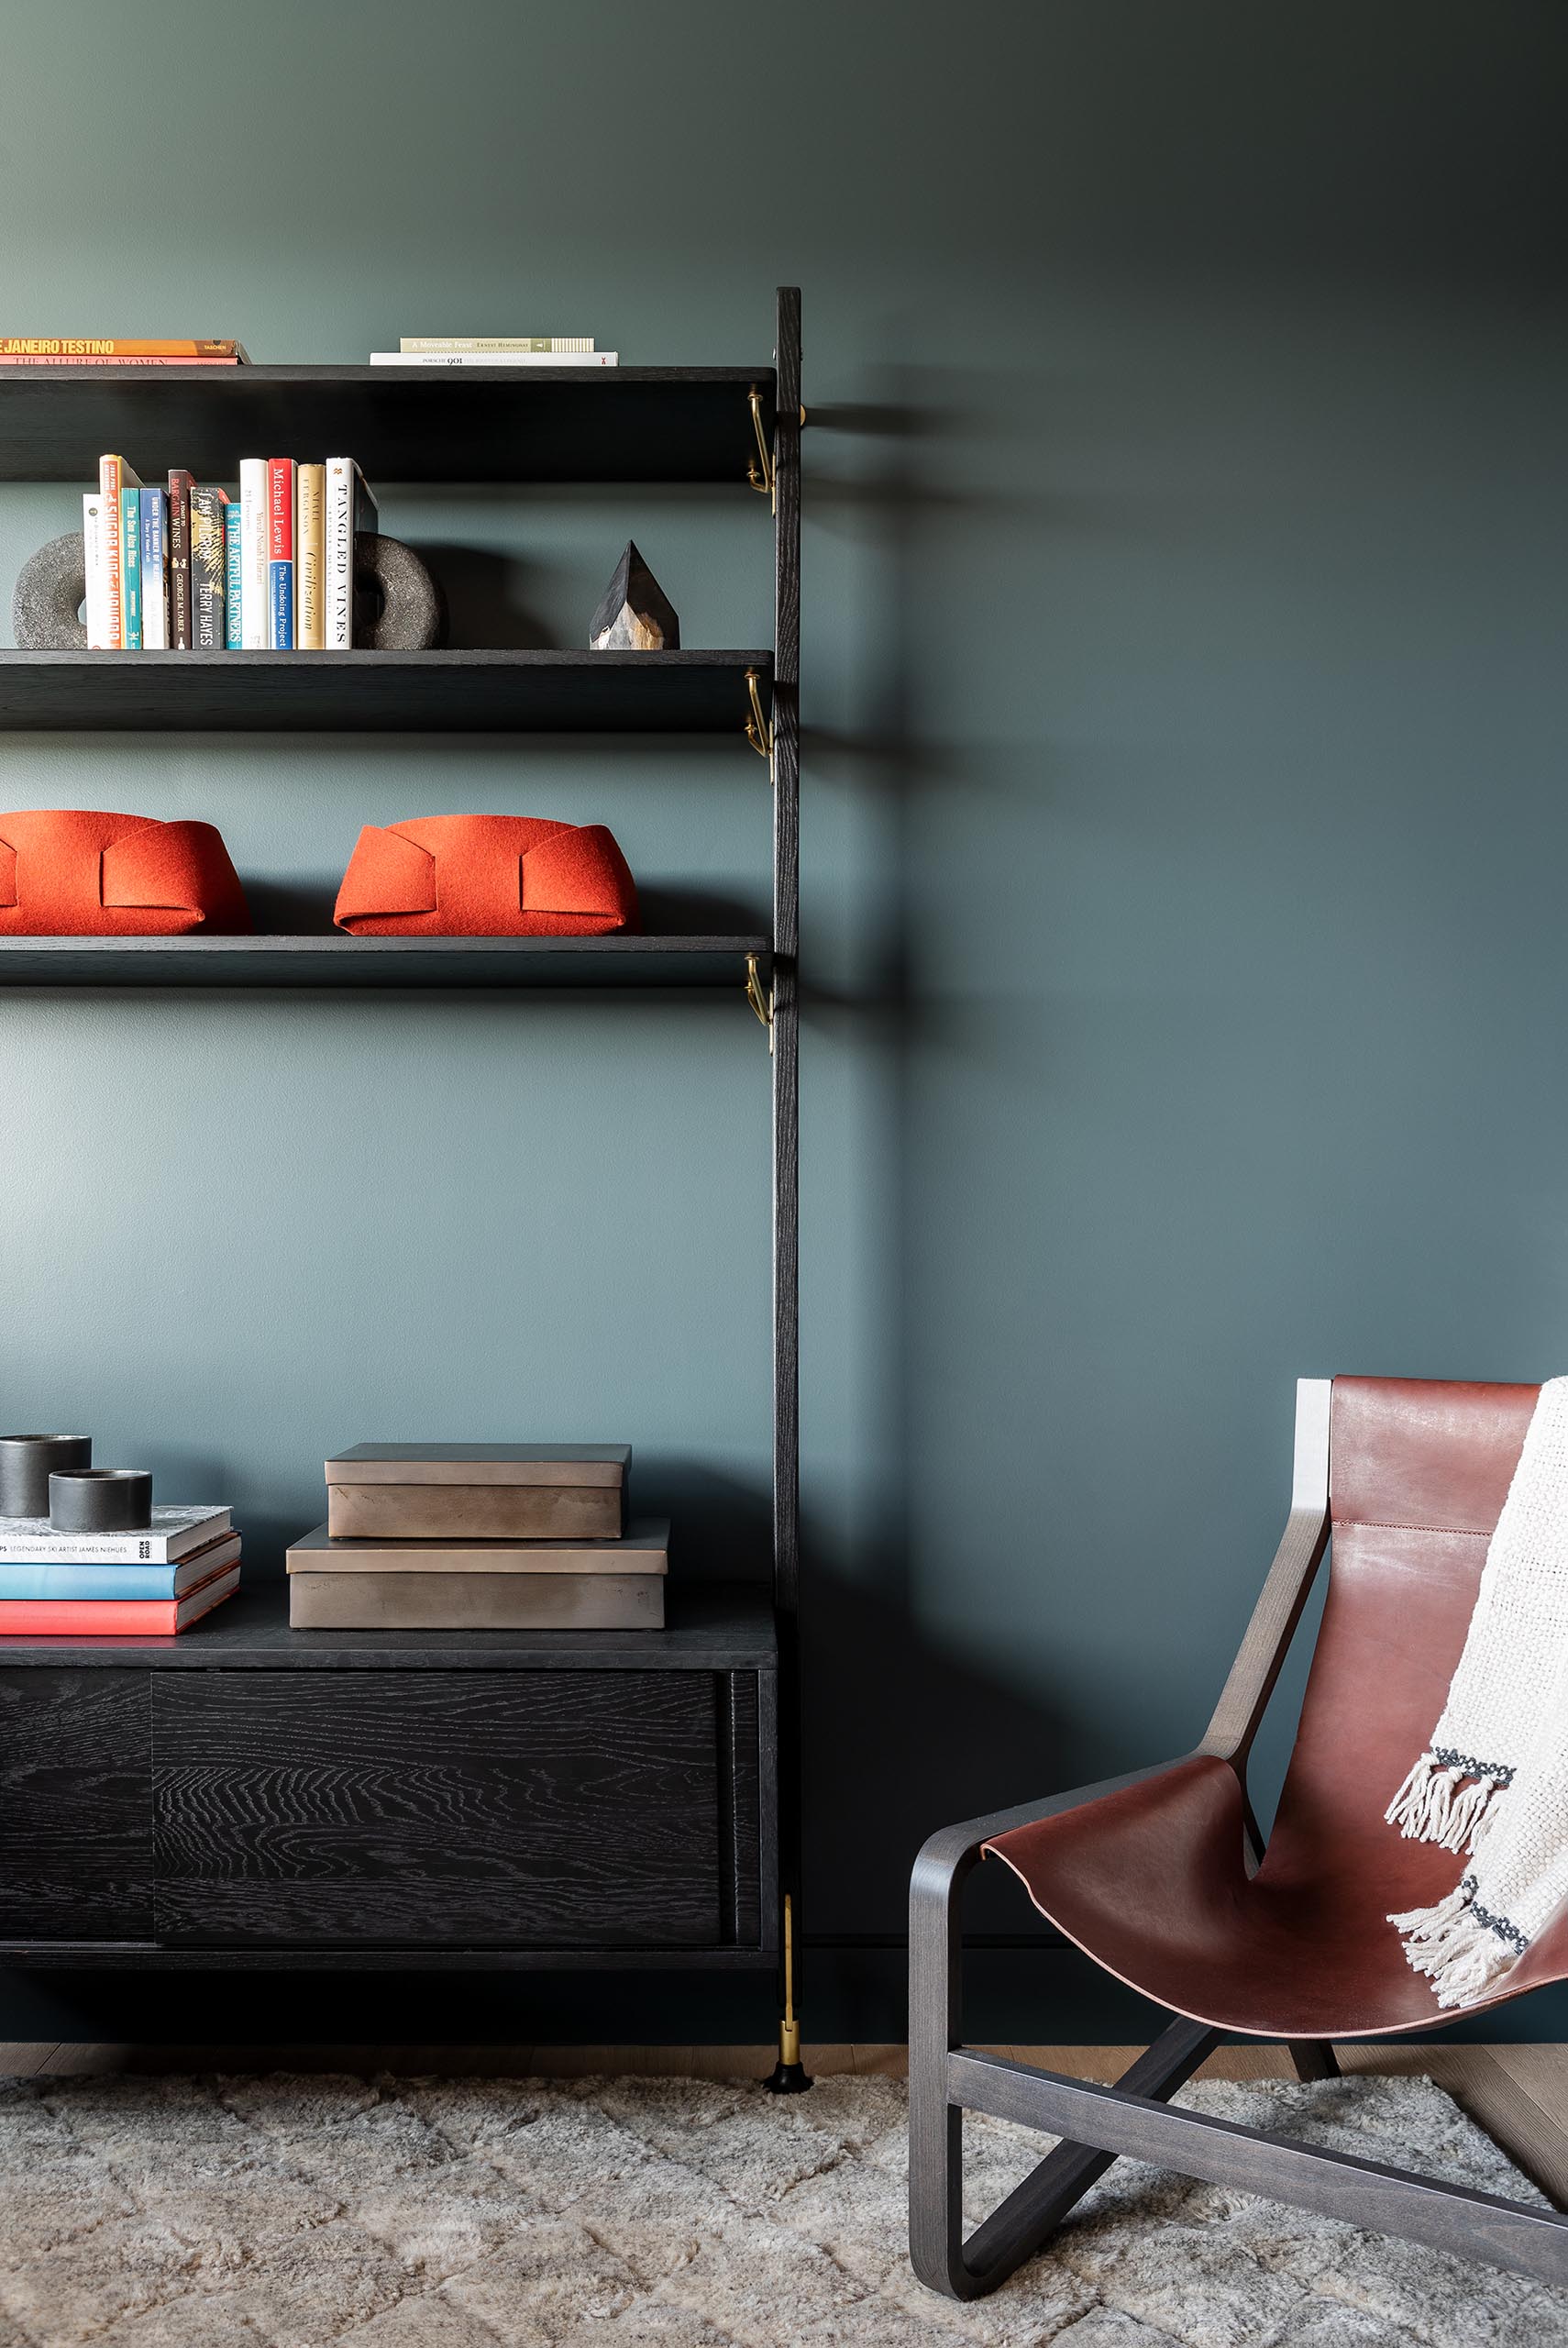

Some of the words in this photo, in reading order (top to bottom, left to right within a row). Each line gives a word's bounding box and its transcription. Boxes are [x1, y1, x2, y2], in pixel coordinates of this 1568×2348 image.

[4, 339, 60, 354] JANEIRO
[61, 340, 114, 354] TESTINO
[151, 497, 160, 515] UNDER
[171, 478, 180, 516] BARGAIN
[273, 468, 284, 515] Michael
[127, 506, 136, 518] The
[198, 500, 212, 515] AM
[256, 512, 264, 533] Yuval
[127, 520, 137, 532] Sun
[127, 534, 137, 548] Also
[172, 518, 181, 548] WINES
[198, 516, 213, 559] PILGRIM
[228, 522, 240, 545] THE
[273, 520, 285, 554] Lewis
[337, 484, 348, 574] TANGLED
[127, 549, 137, 568] Rises
[228, 547, 241, 589] ARTFUL
[199, 582, 214, 612] TERRY
[278, 583, 287, 616] Undoing
[304, 552, 316, 630] Civilization
[229, 590, 242, 642] PARTNERS
[337, 585, 347, 643] VINES
[200, 615, 214, 646] HAYES
[279, 618, 287, 647] Project
